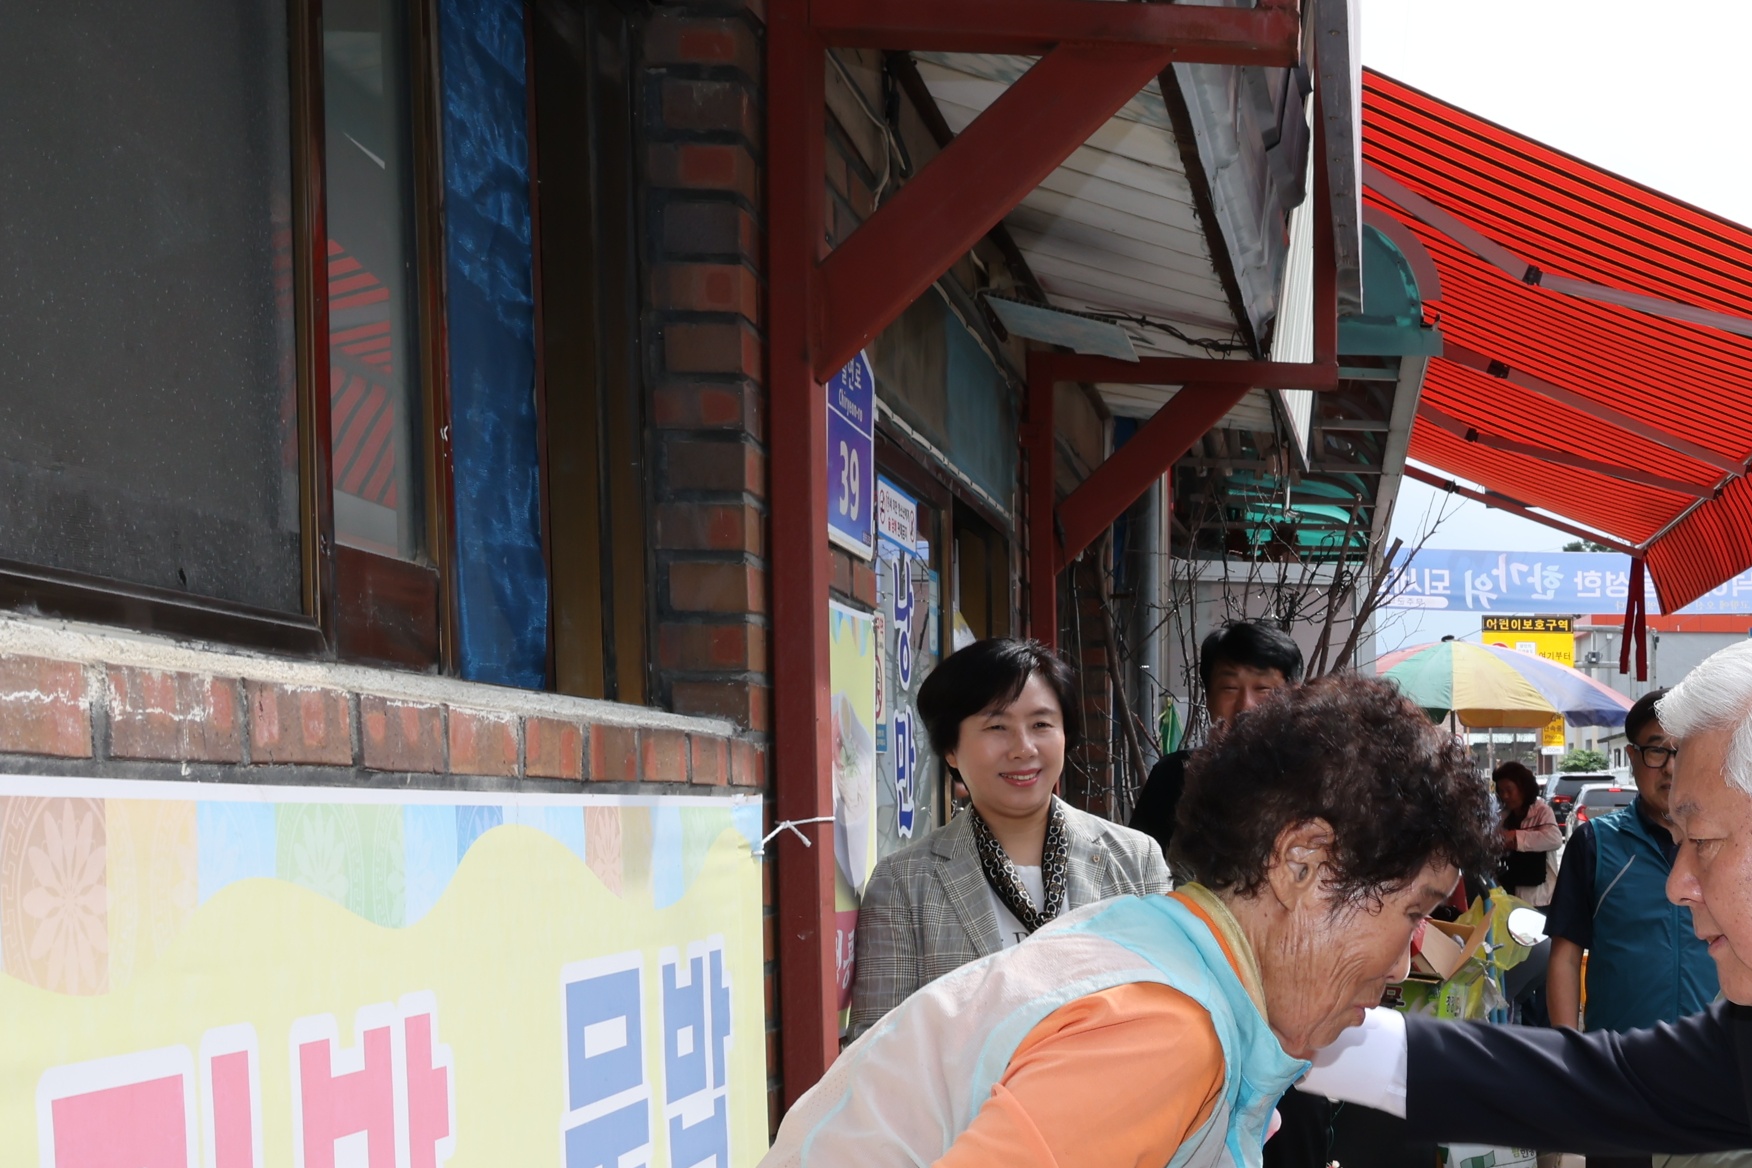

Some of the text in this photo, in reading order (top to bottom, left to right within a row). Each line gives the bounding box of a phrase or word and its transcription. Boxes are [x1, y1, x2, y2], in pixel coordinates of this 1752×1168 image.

[838, 388, 863, 423] Chiryeon-ro
[839, 440, 861, 522] 39
[1486, 618, 1570, 631] 어린이보호구역
[1538, 651, 1571, 660] 여기부터
